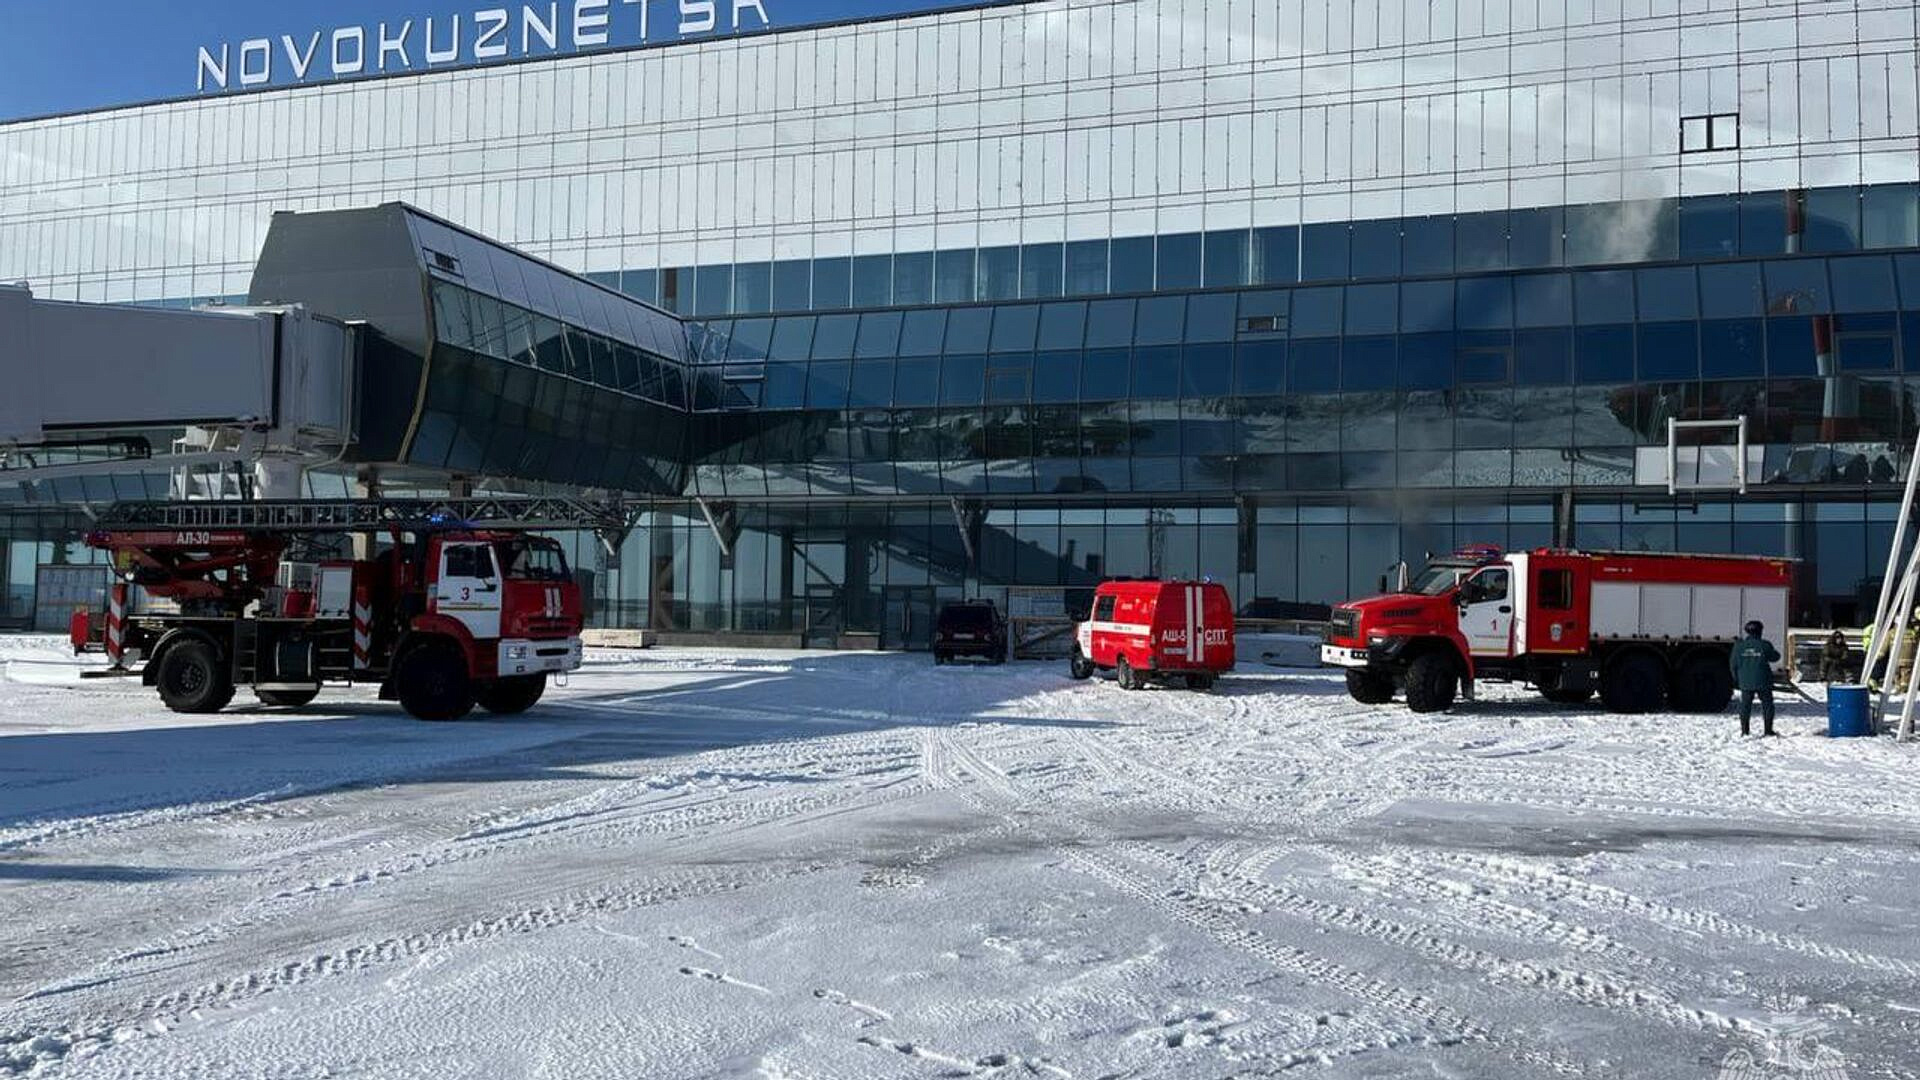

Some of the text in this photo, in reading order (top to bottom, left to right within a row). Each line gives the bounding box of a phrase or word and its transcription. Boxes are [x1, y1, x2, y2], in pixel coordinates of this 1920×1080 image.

[176, 531, 210, 545] АЛ-30
[461, 587, 470, 601] 3
[1491, 619, 1497, 631] 1
[1204, 628, 1227, 641] СПТ
